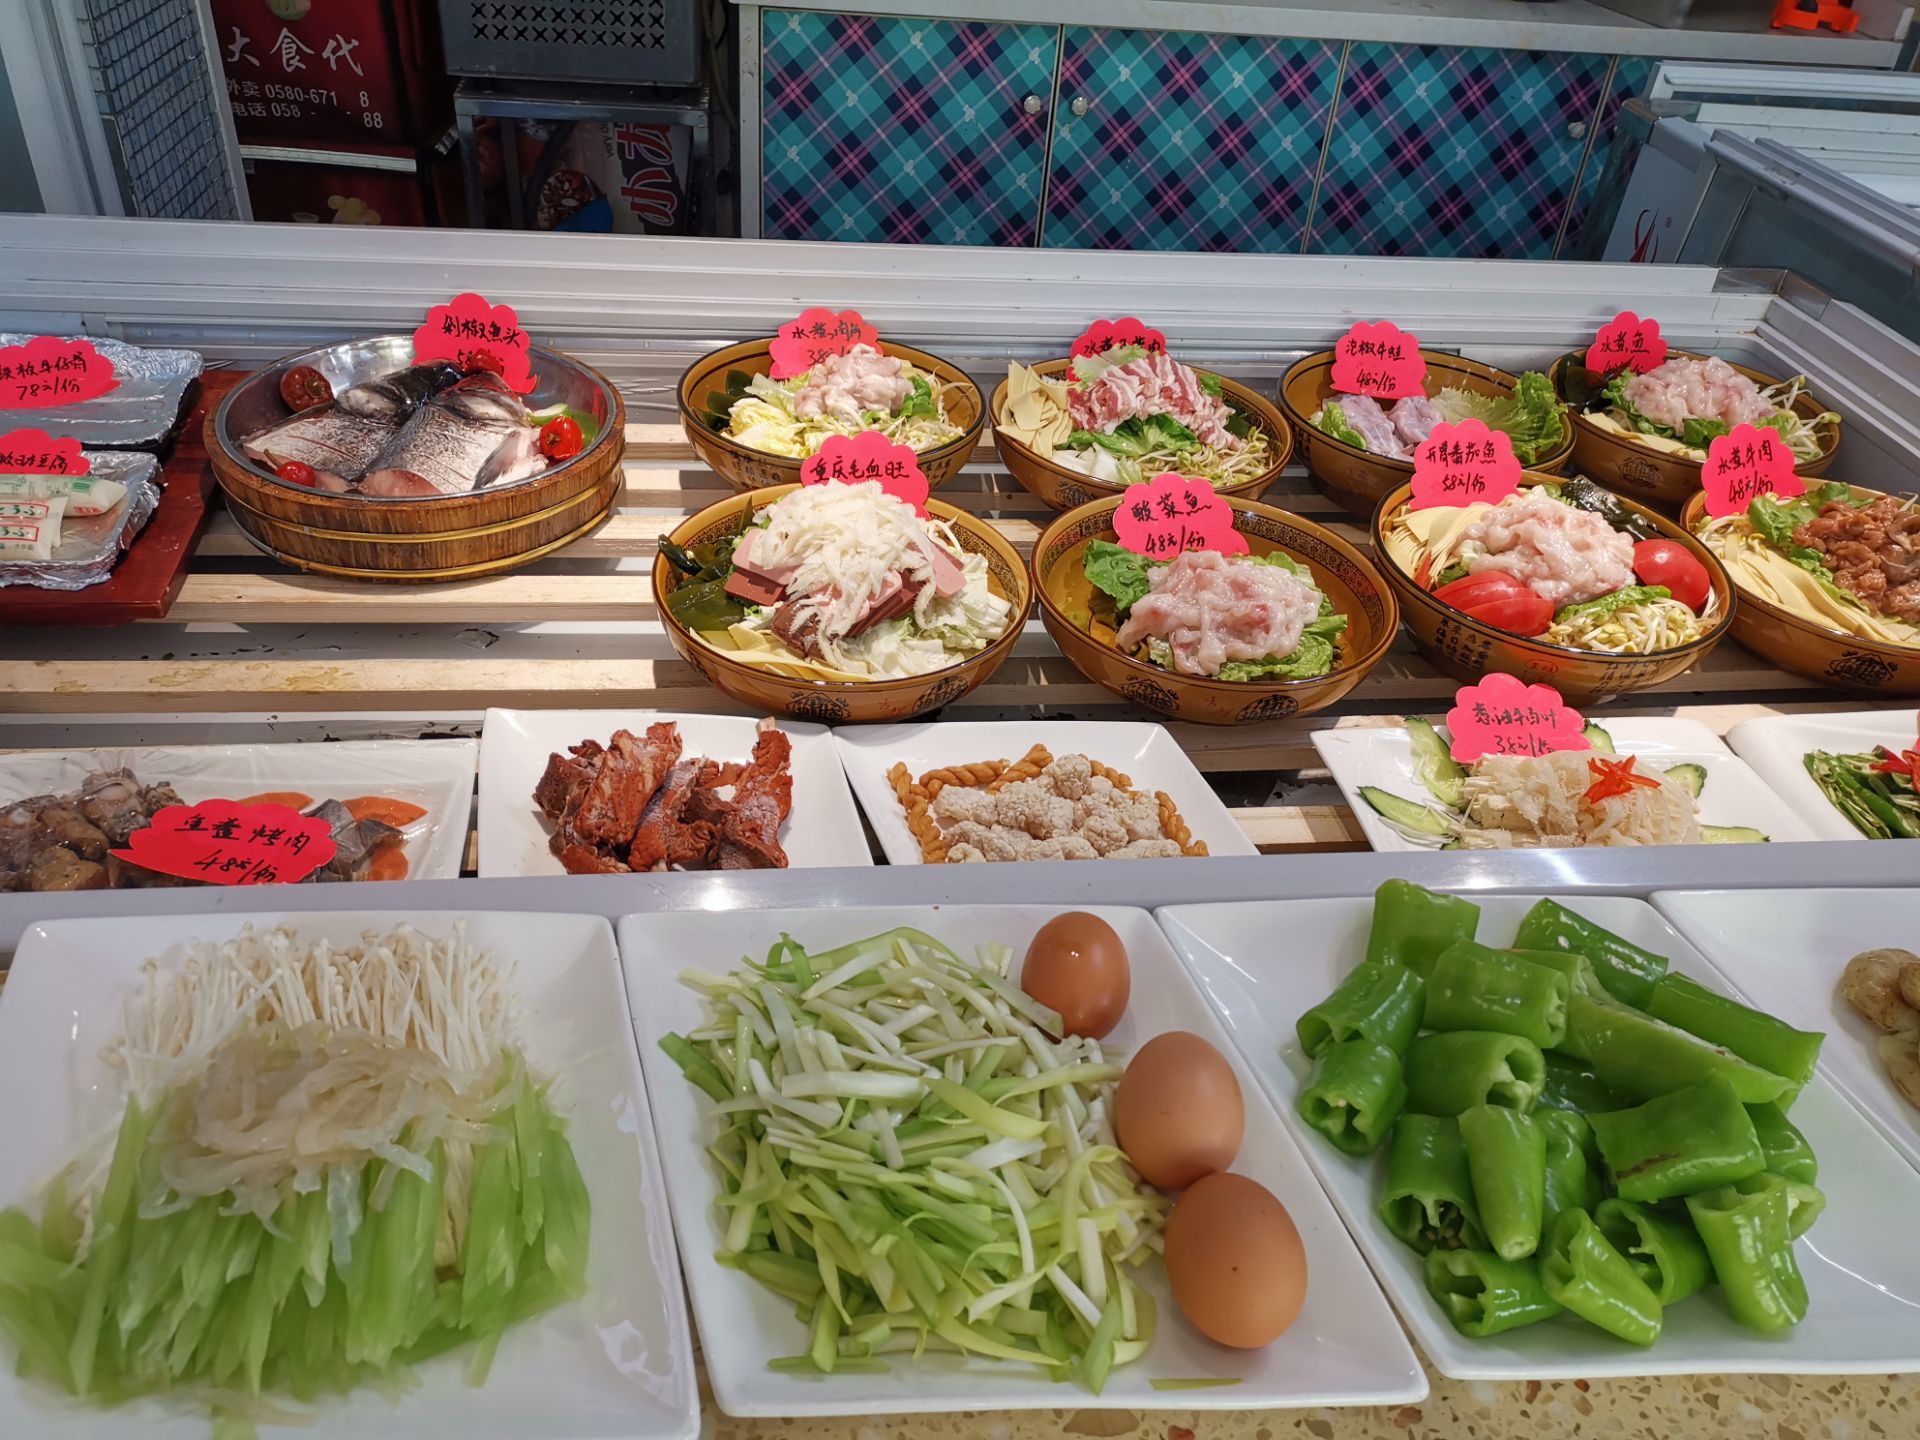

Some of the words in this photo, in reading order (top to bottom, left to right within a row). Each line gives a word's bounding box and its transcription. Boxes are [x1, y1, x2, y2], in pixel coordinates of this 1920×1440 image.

[227, 26, 364, 77] 大食代
[227, 78, 261, 97] 外卖
[265, 84, 338, 107] 0580-671
[442, 314, 520, 348] 剁椒鱼头
[1346, 338, 1406, 361] 泡椒牛蛙
[810, 455, 910, 483] 重庆毛血旺
[1131, 490, 1213, 522] 酸菜鱼
